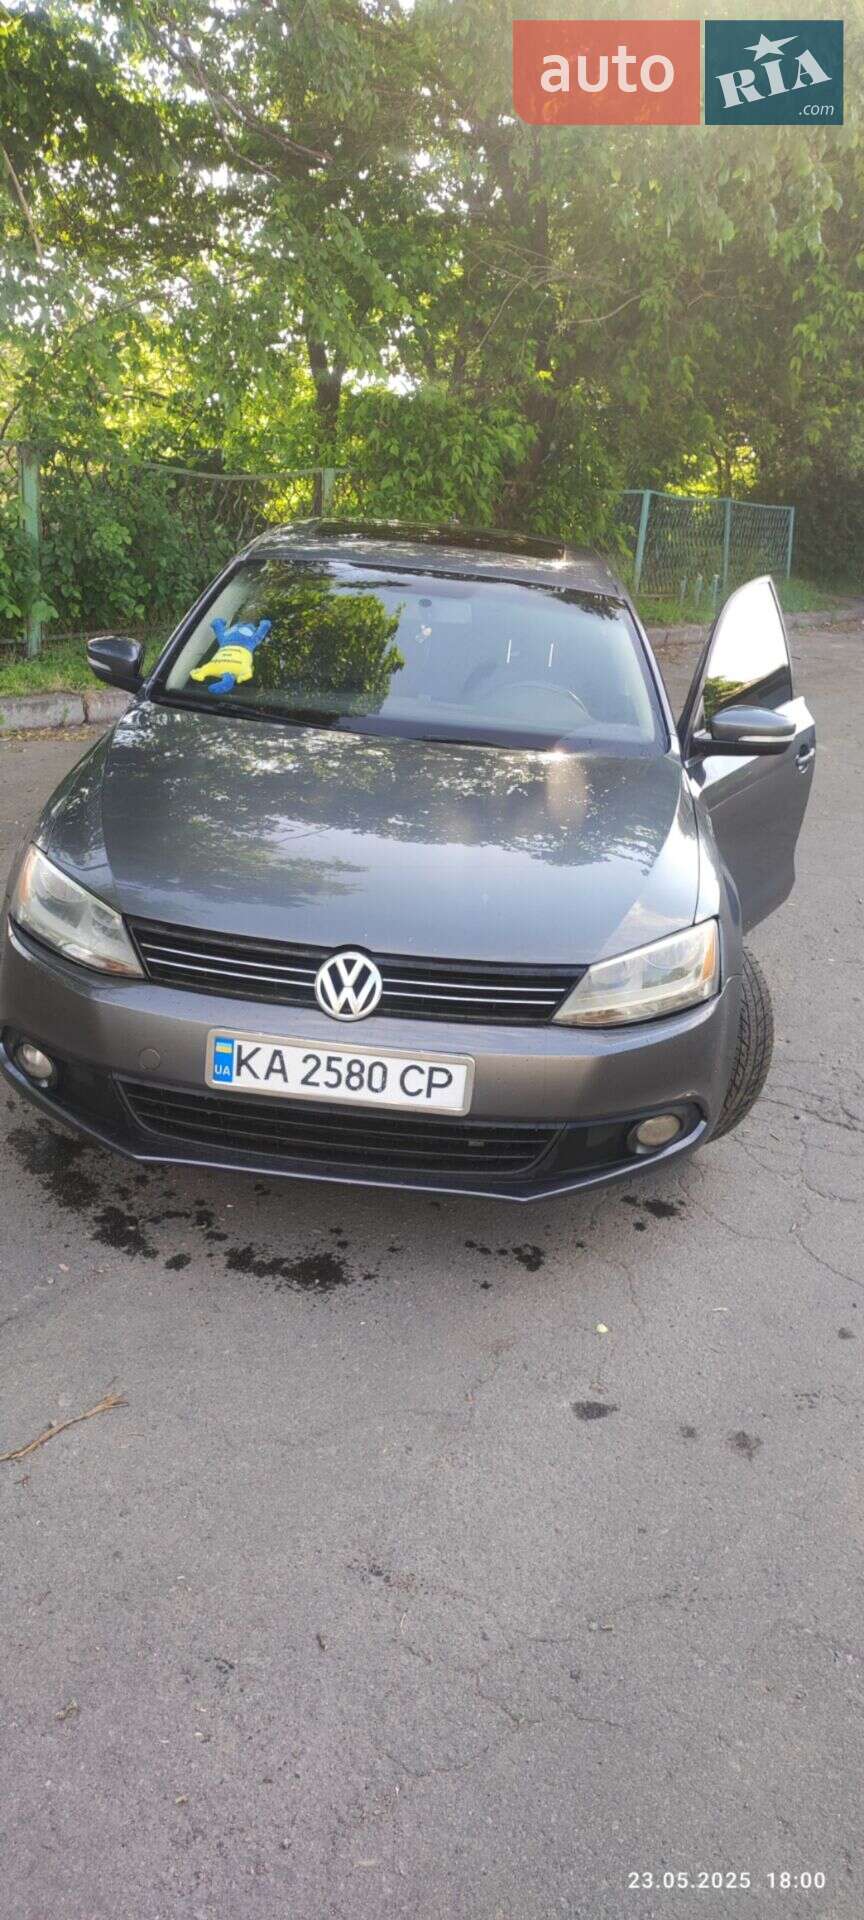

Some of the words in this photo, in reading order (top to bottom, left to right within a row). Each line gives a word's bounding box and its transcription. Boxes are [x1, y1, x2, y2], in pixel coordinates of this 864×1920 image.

[315, 951, 383, 1021] VW
[214, 1063, 231, 1076] UA
[235, 1044, 289, 1083] KA
[300, 1054, 388, 1093] 2580
[399, 1064, 453, 1099] CP
